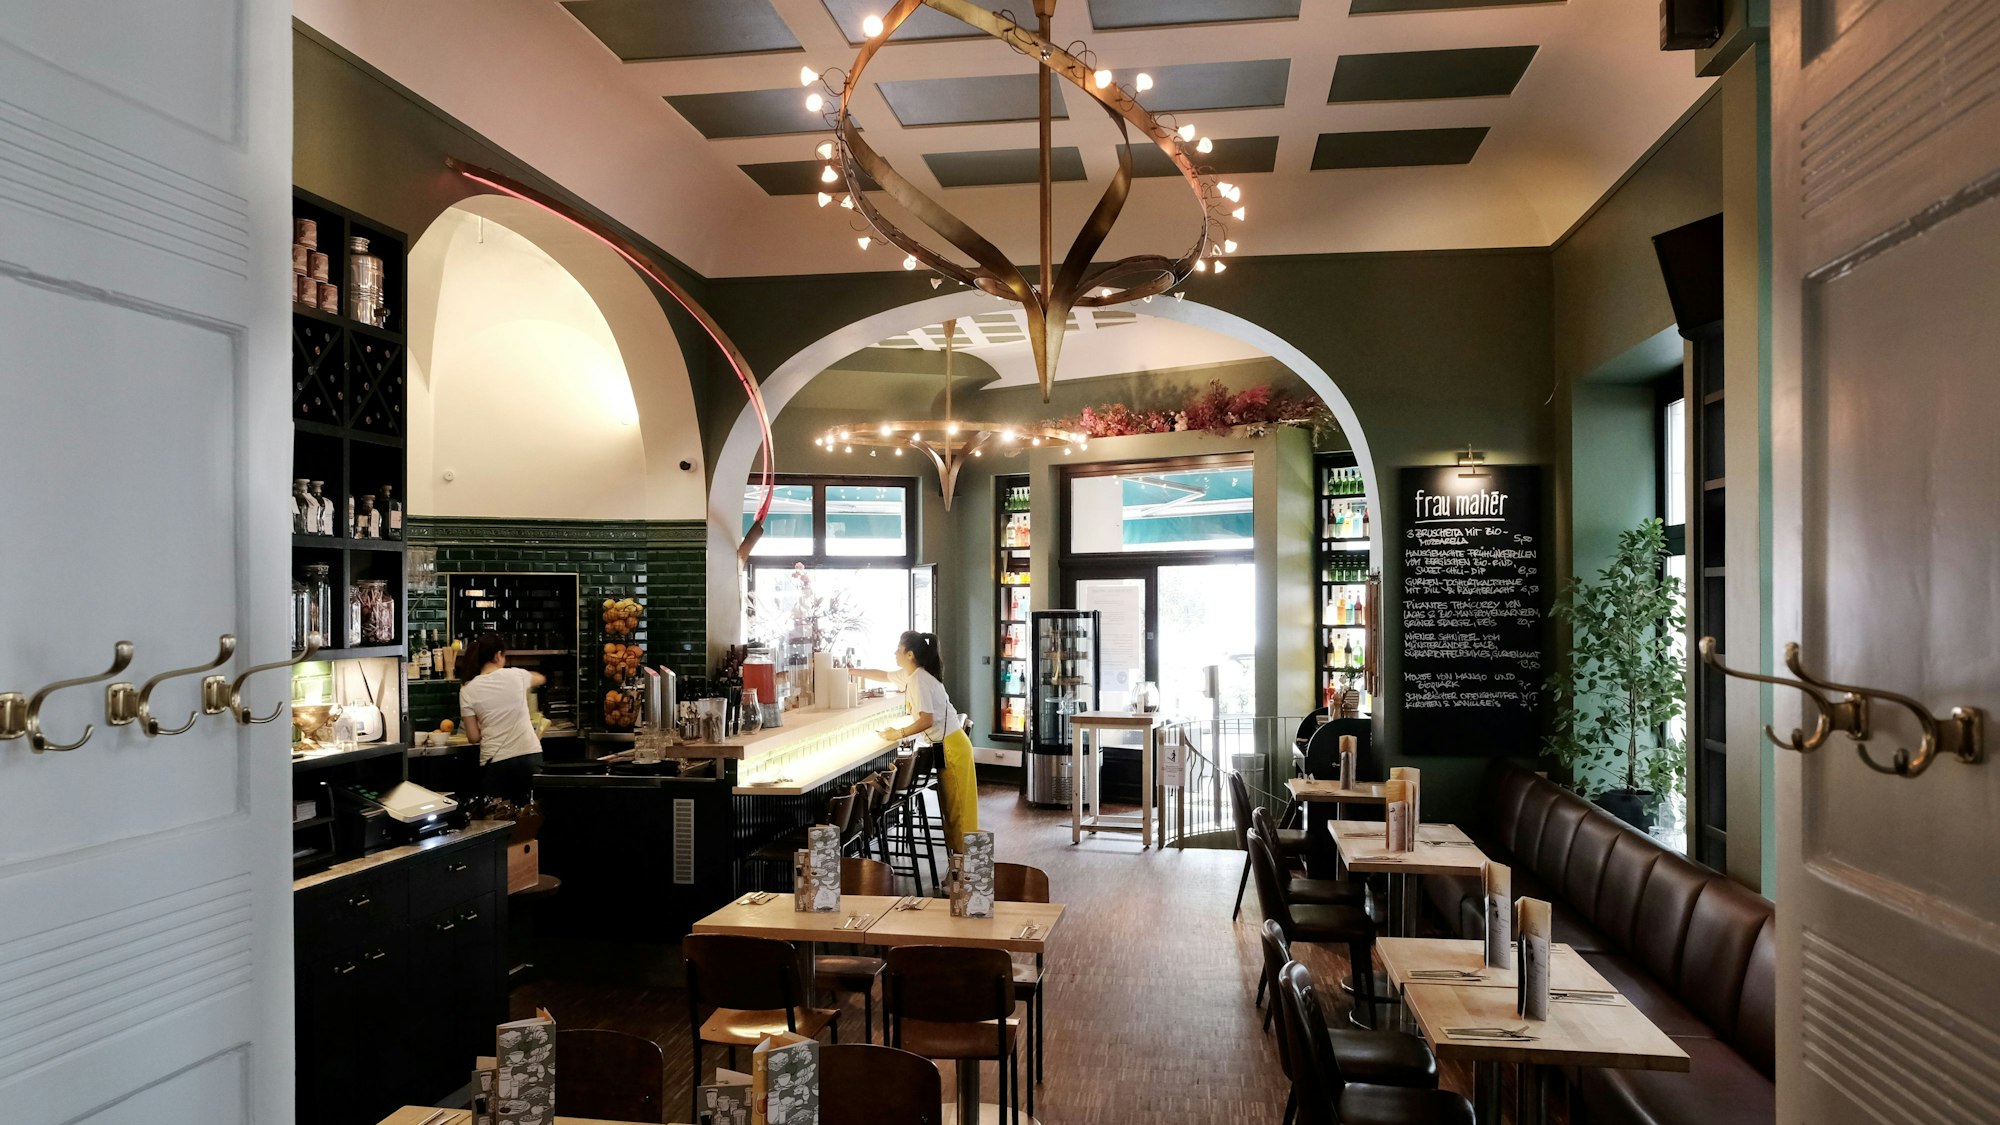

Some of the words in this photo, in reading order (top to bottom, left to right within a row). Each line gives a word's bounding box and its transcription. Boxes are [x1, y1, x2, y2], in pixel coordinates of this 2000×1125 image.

[1415, 490, 1450, 518] frau
[1406, 529, 1414, 538] 3
[1514, 534, 1532, 545] 5,50
[1454, 672, 1487, 682] MANGO
